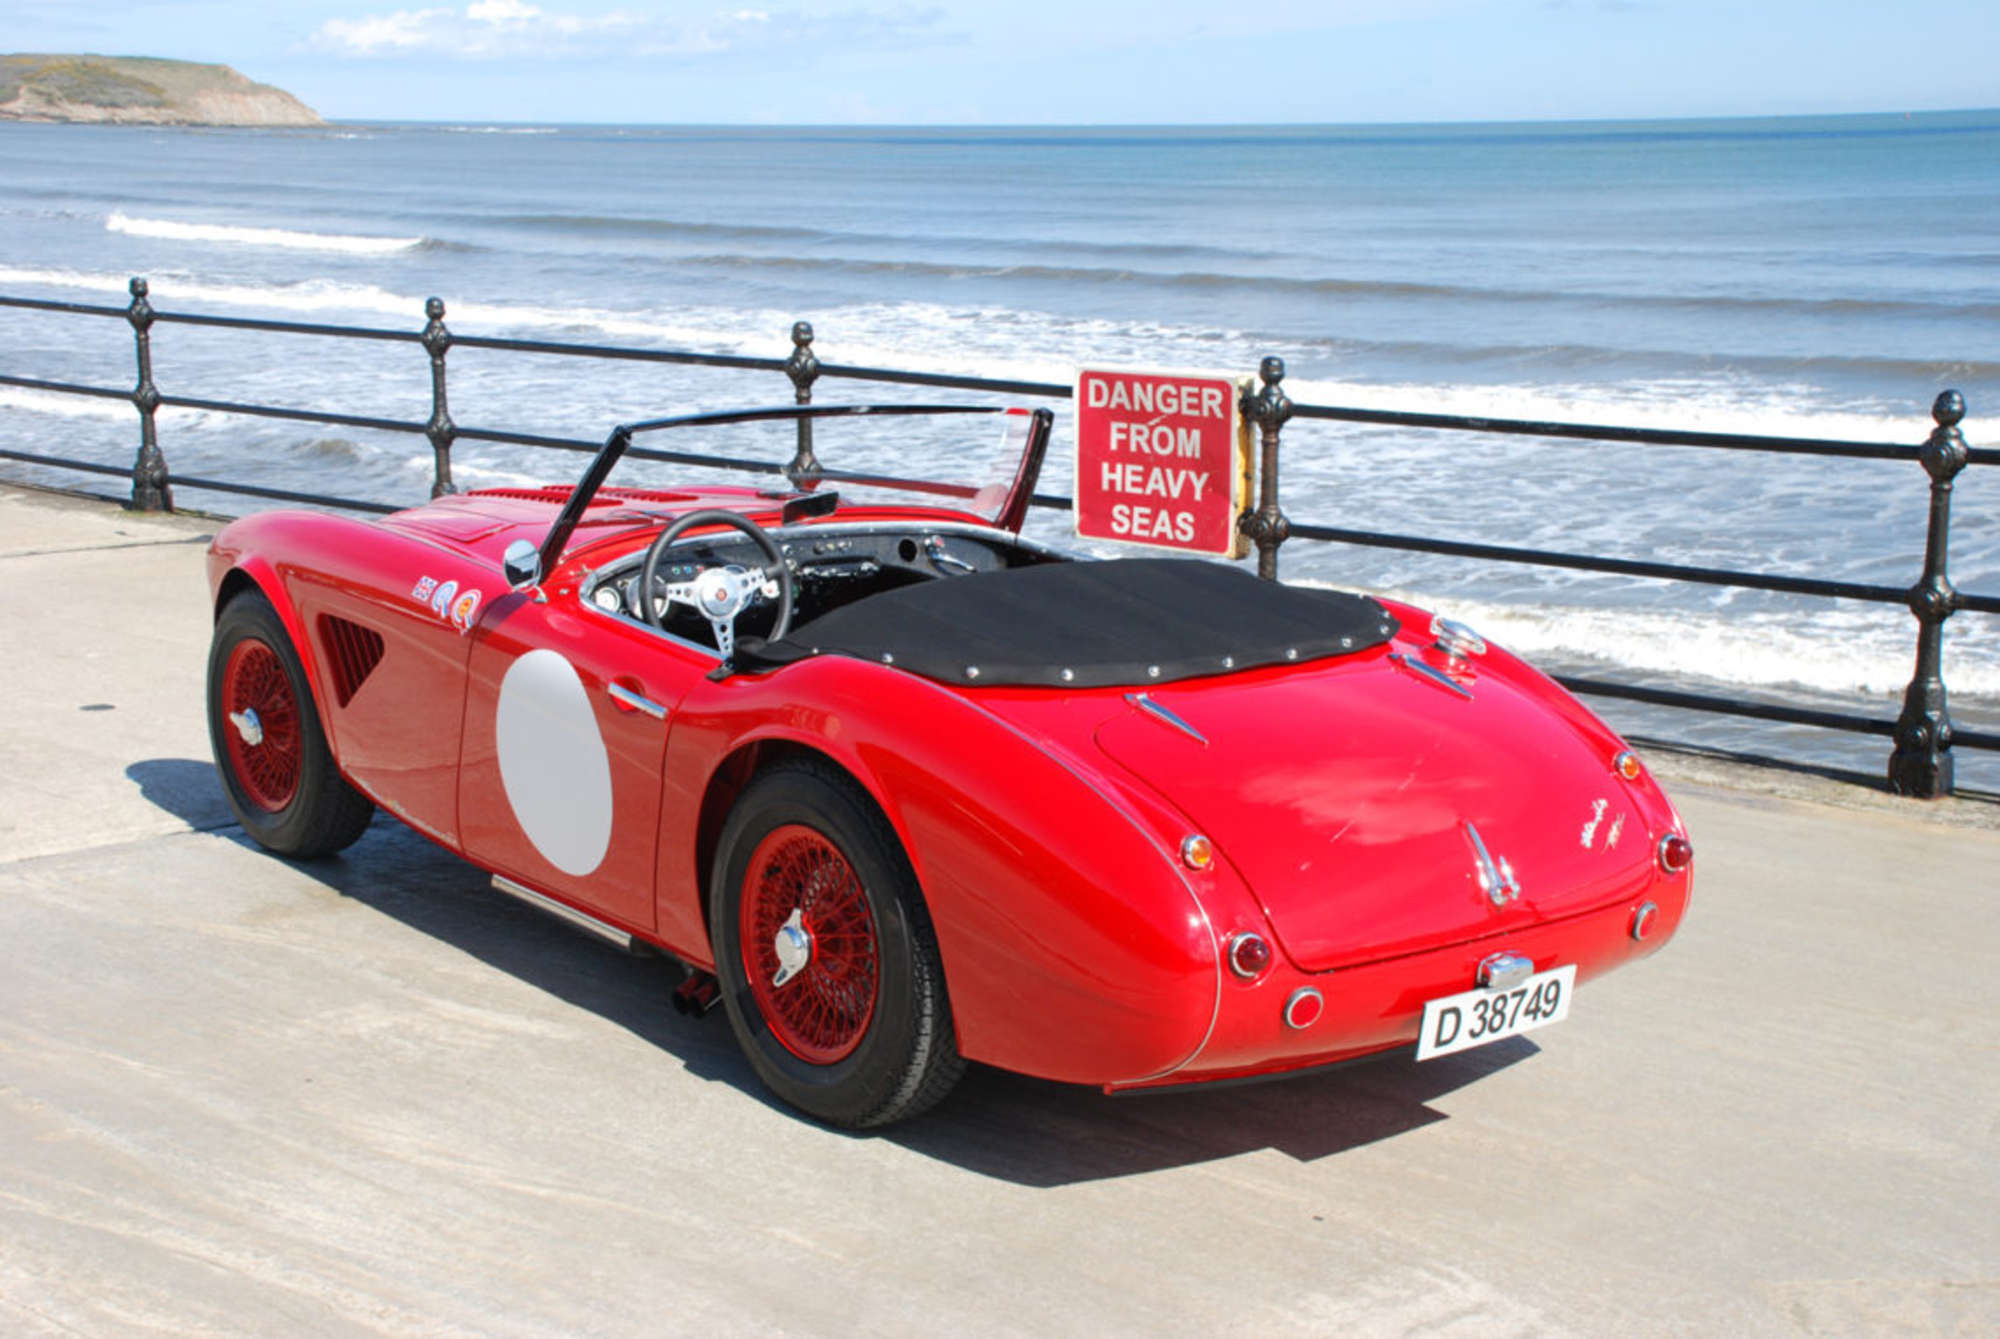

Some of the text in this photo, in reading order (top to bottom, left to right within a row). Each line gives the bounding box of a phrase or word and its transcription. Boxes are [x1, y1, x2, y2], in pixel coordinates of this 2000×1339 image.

[1088, 378, 1224, 419] DANGER
[1110, 421, 1201, 459] FROM
[1101, 462, 1210, 501] HEAVY
[1111, 504, 1195, 542] SEAS
[1434, 979, 1561, 1048] D 38749
